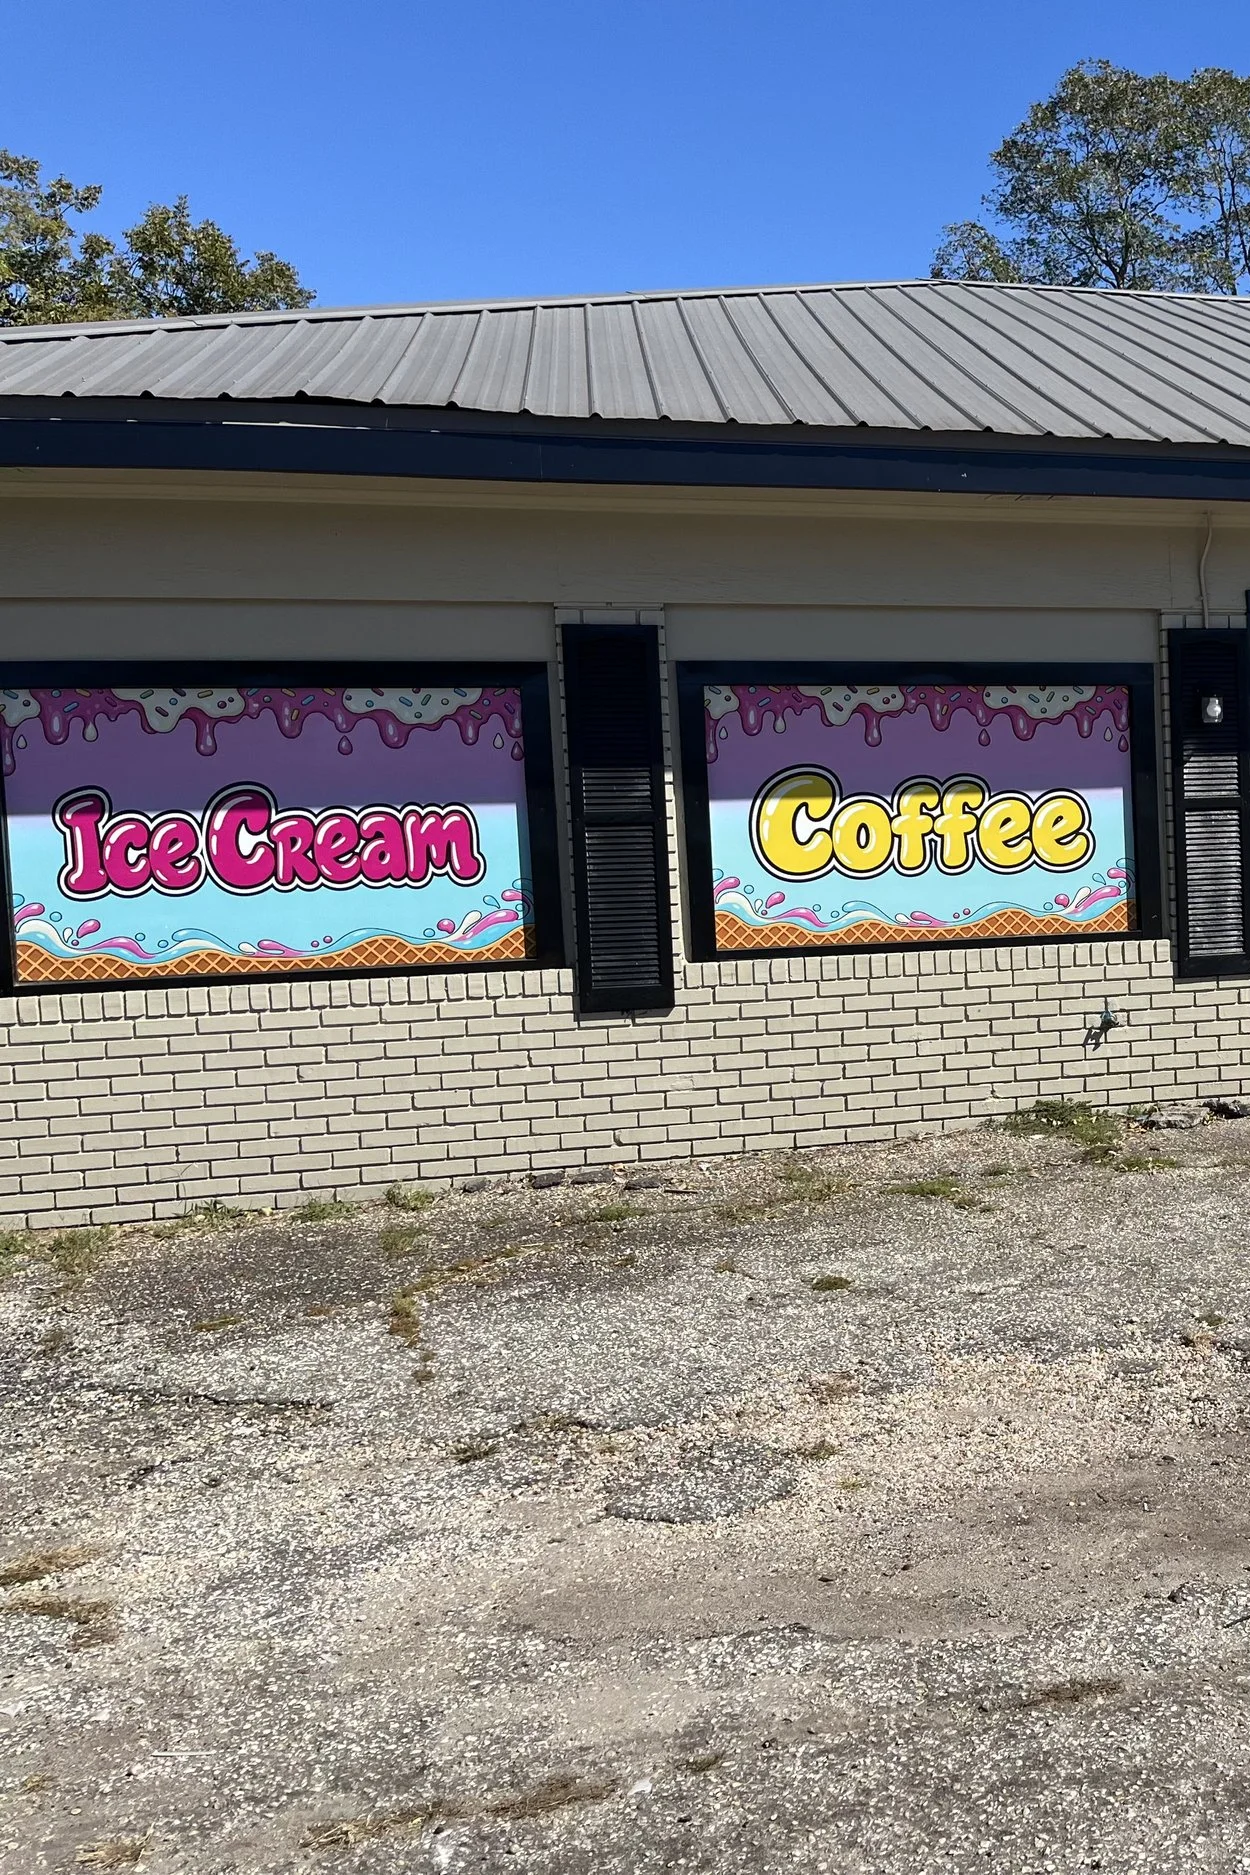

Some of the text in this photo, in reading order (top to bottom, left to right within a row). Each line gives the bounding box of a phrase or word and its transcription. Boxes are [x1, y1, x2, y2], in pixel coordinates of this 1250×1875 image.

[59, 791, 480, 893] Ice Cream
[754, 770, 1090, 876] Coffee
